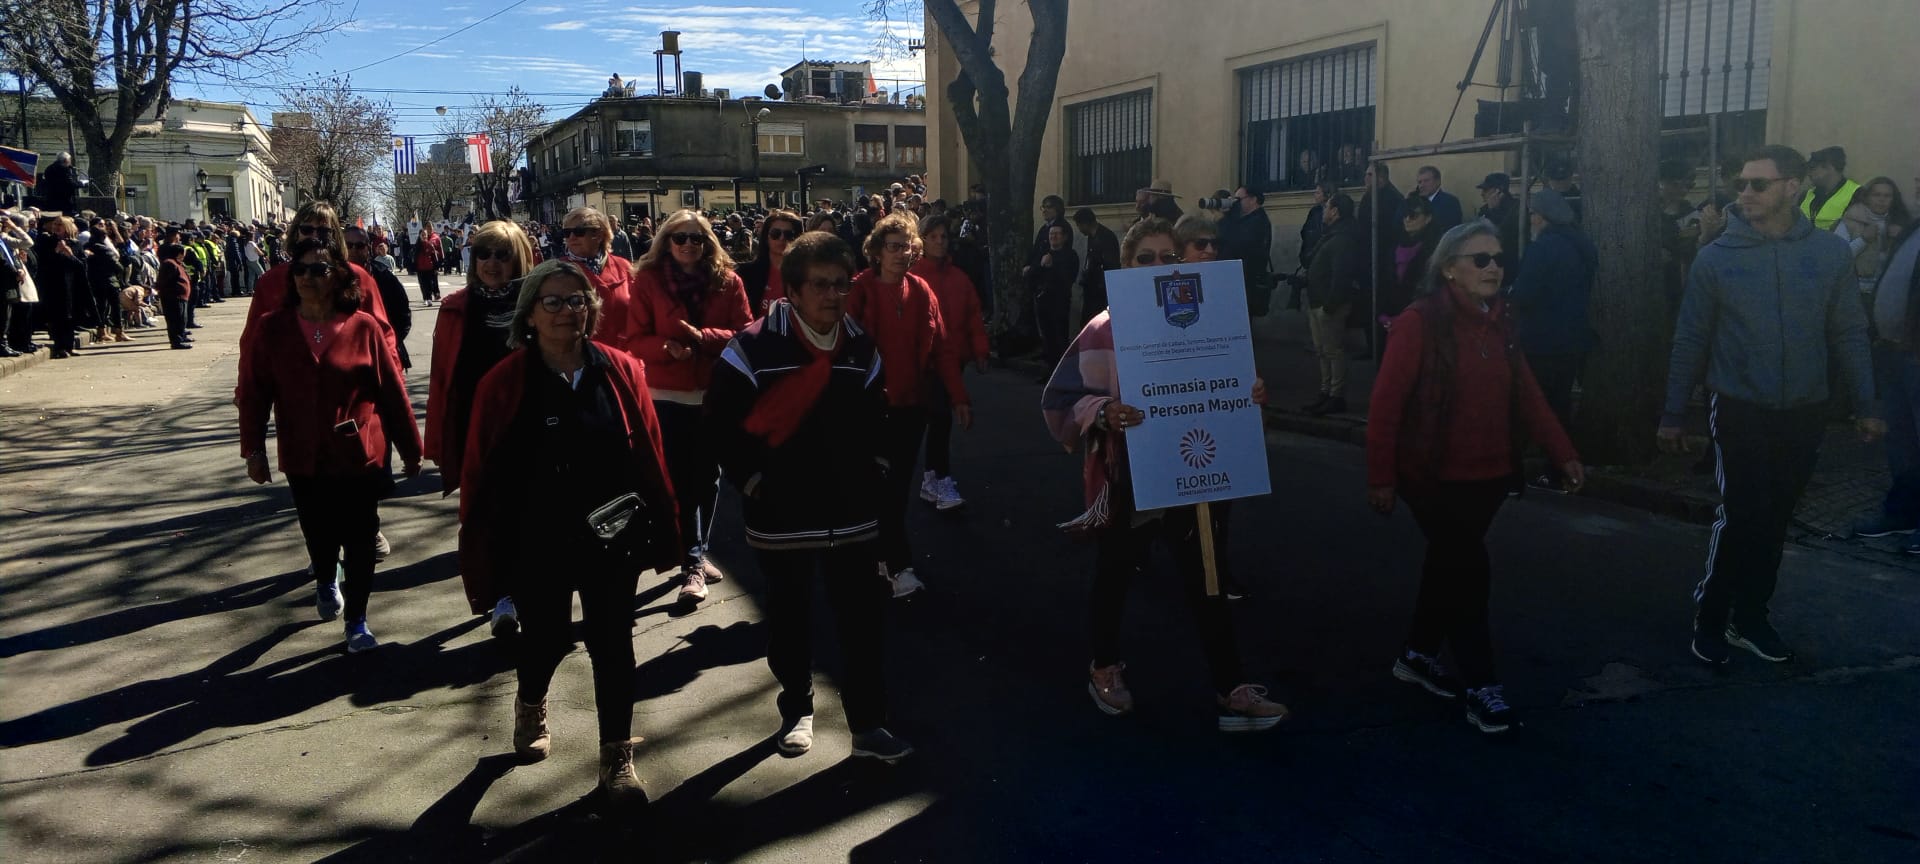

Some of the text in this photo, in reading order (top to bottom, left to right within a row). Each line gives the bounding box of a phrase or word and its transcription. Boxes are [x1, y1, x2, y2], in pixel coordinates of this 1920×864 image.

[1142, 377, 1239, 397] Gimnasia para
[1149, 404, 1205, 418] Persona
[1208, 397, 1251, 414] Mayor.
[1176, 471, 1230, 490] FLORIDA
